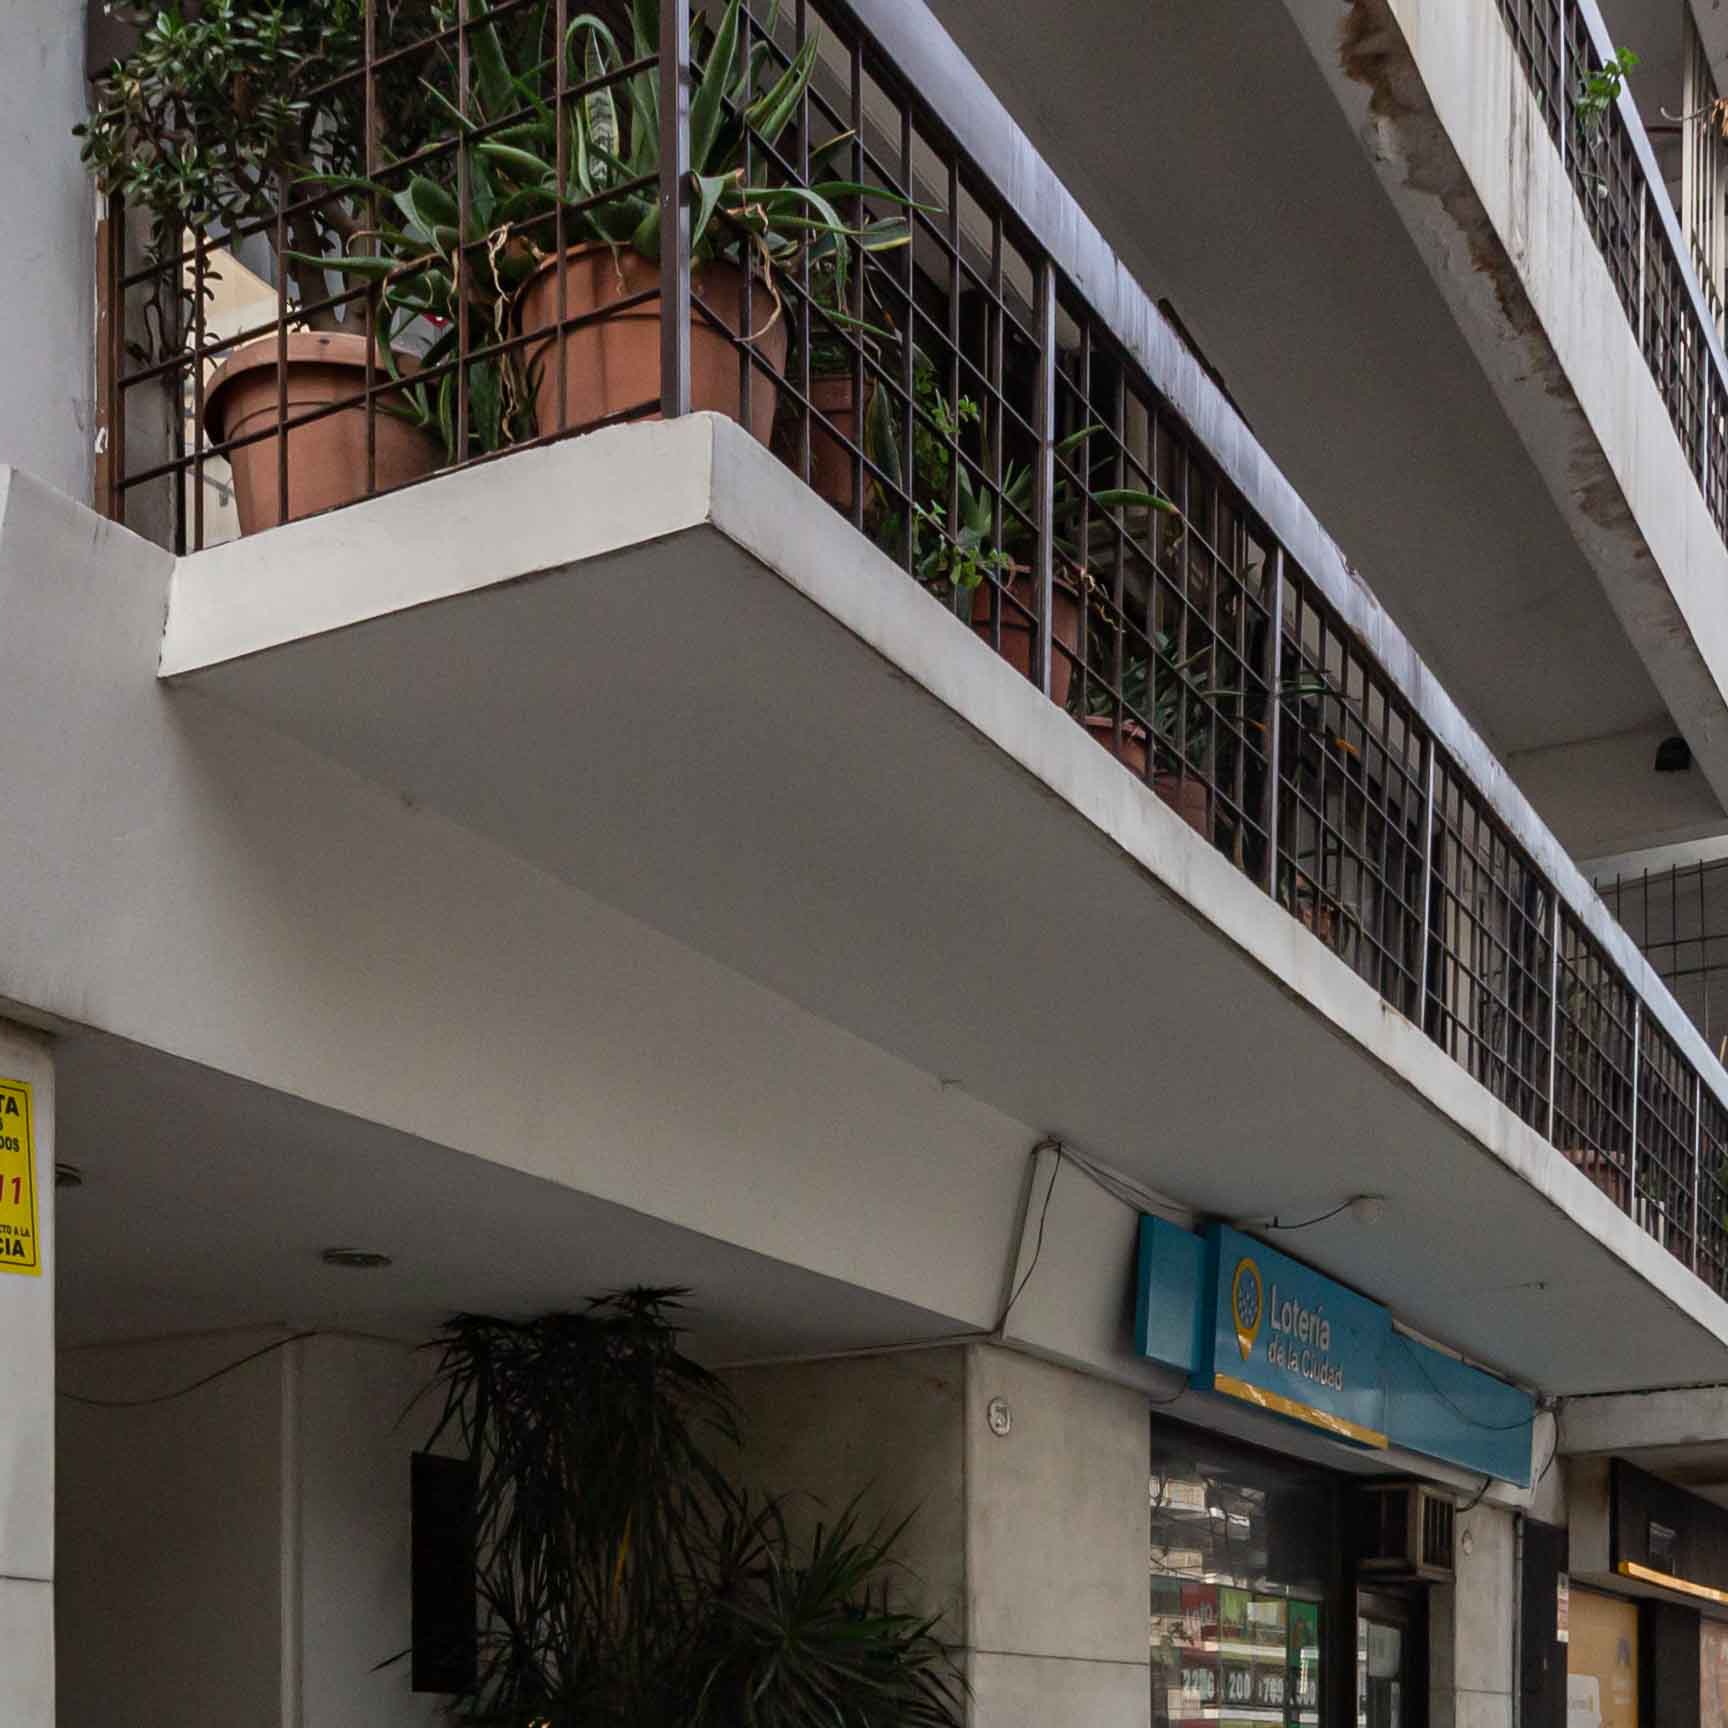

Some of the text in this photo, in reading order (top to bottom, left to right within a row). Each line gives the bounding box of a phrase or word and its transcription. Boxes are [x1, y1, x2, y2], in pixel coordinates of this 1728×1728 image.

[1271, 1284, 1330, 1352] Lotería
[1268, 1334, 1344, 1392] de la Ciudad
